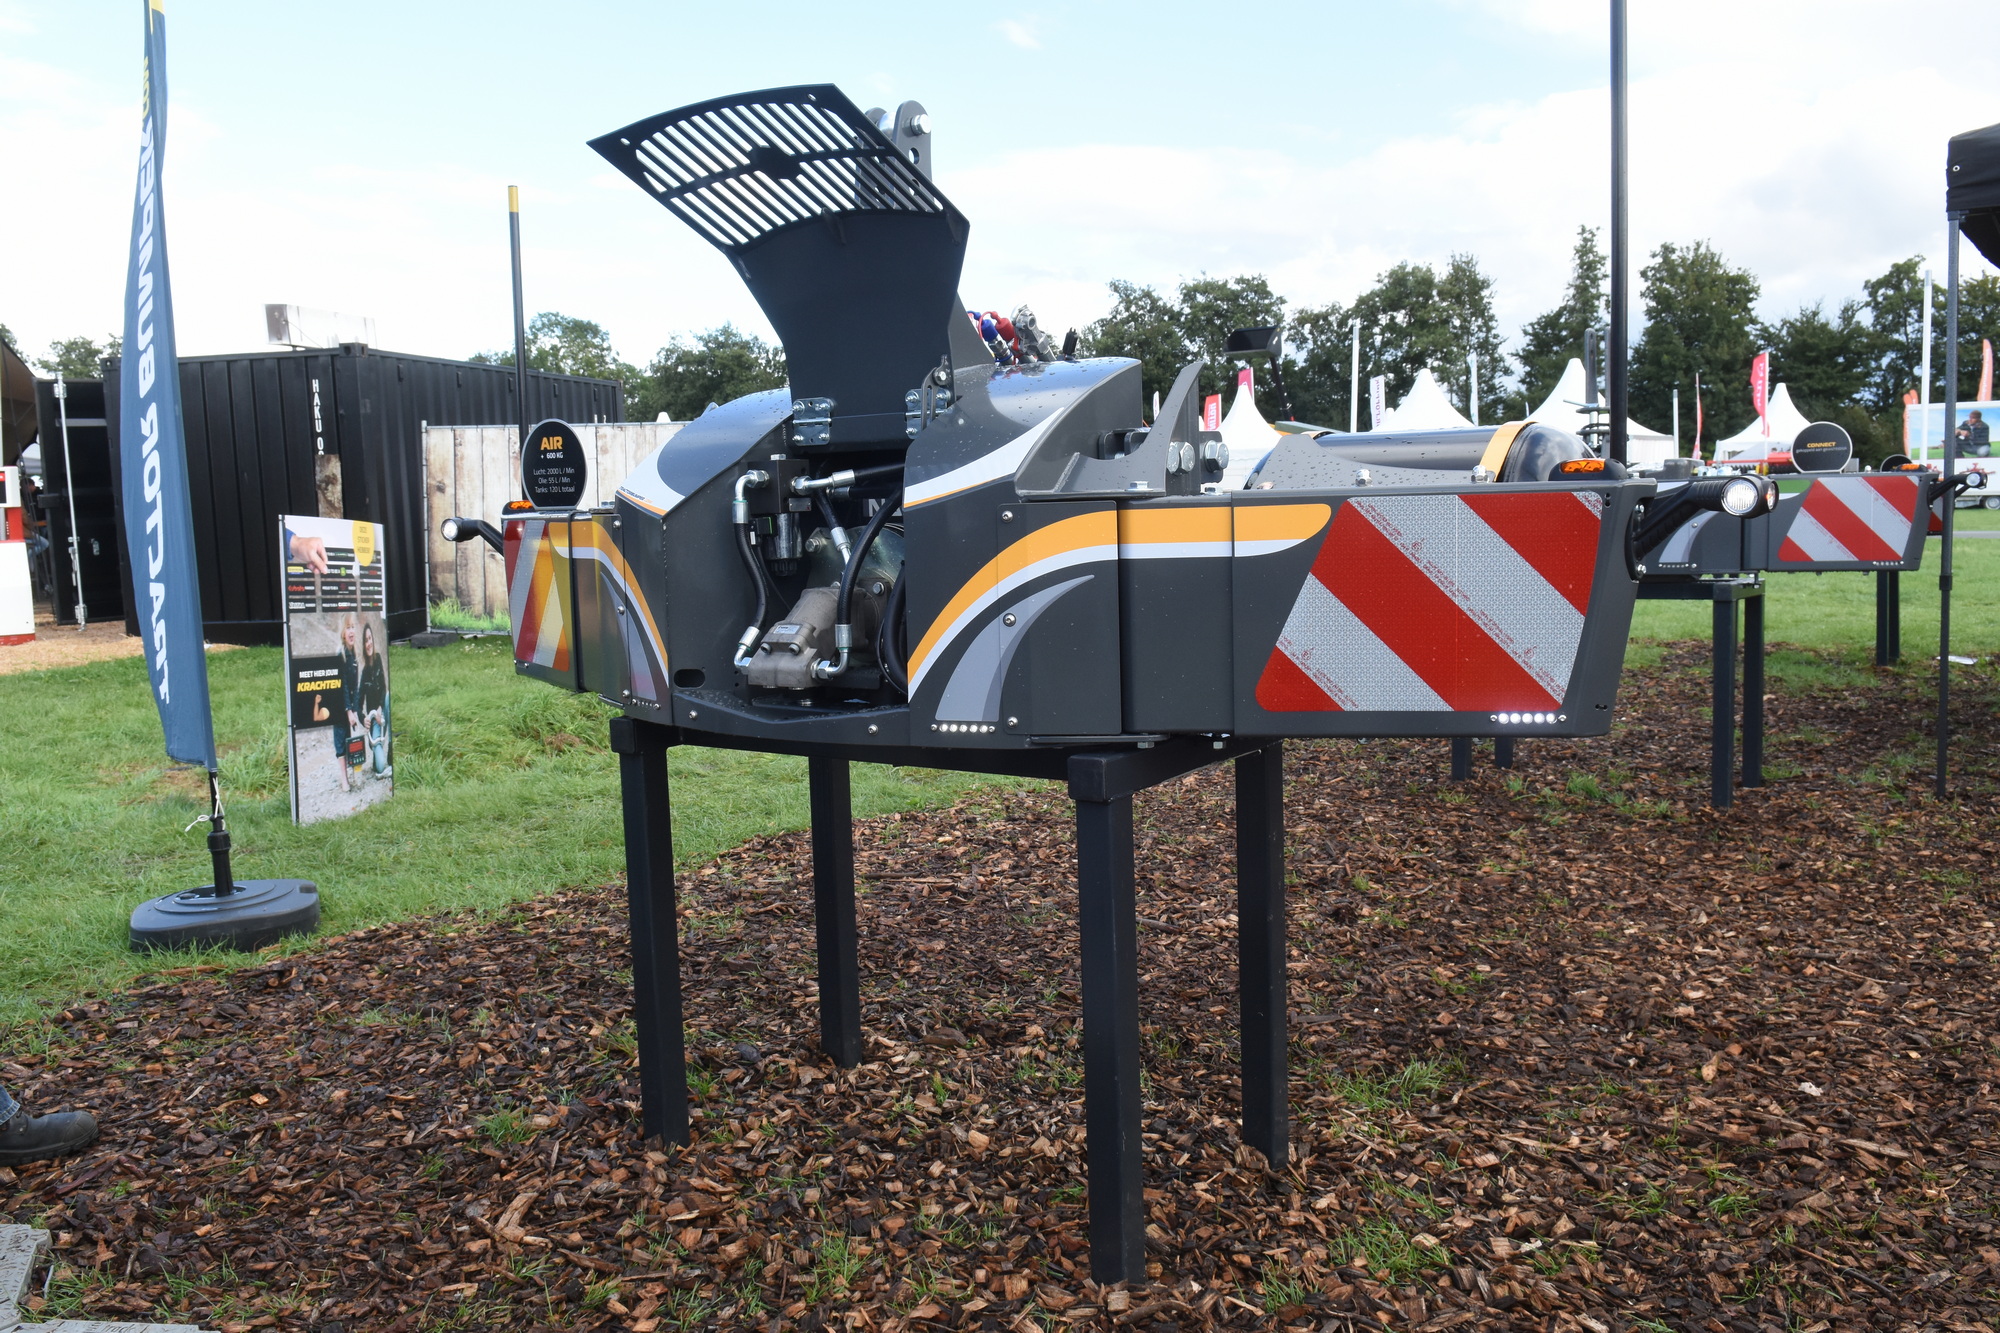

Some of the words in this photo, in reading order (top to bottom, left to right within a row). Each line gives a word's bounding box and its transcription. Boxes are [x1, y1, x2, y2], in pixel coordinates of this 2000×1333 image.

[312, 378, 323, 433] HAKU
[540, 436, 563, 451] AIR
[556, 451, 564, 459] KG
[299, 670, 313, 679] MEET
[313, 669, 326, 678] HIER
[296, 678, 342, 693] KRACHTEN
